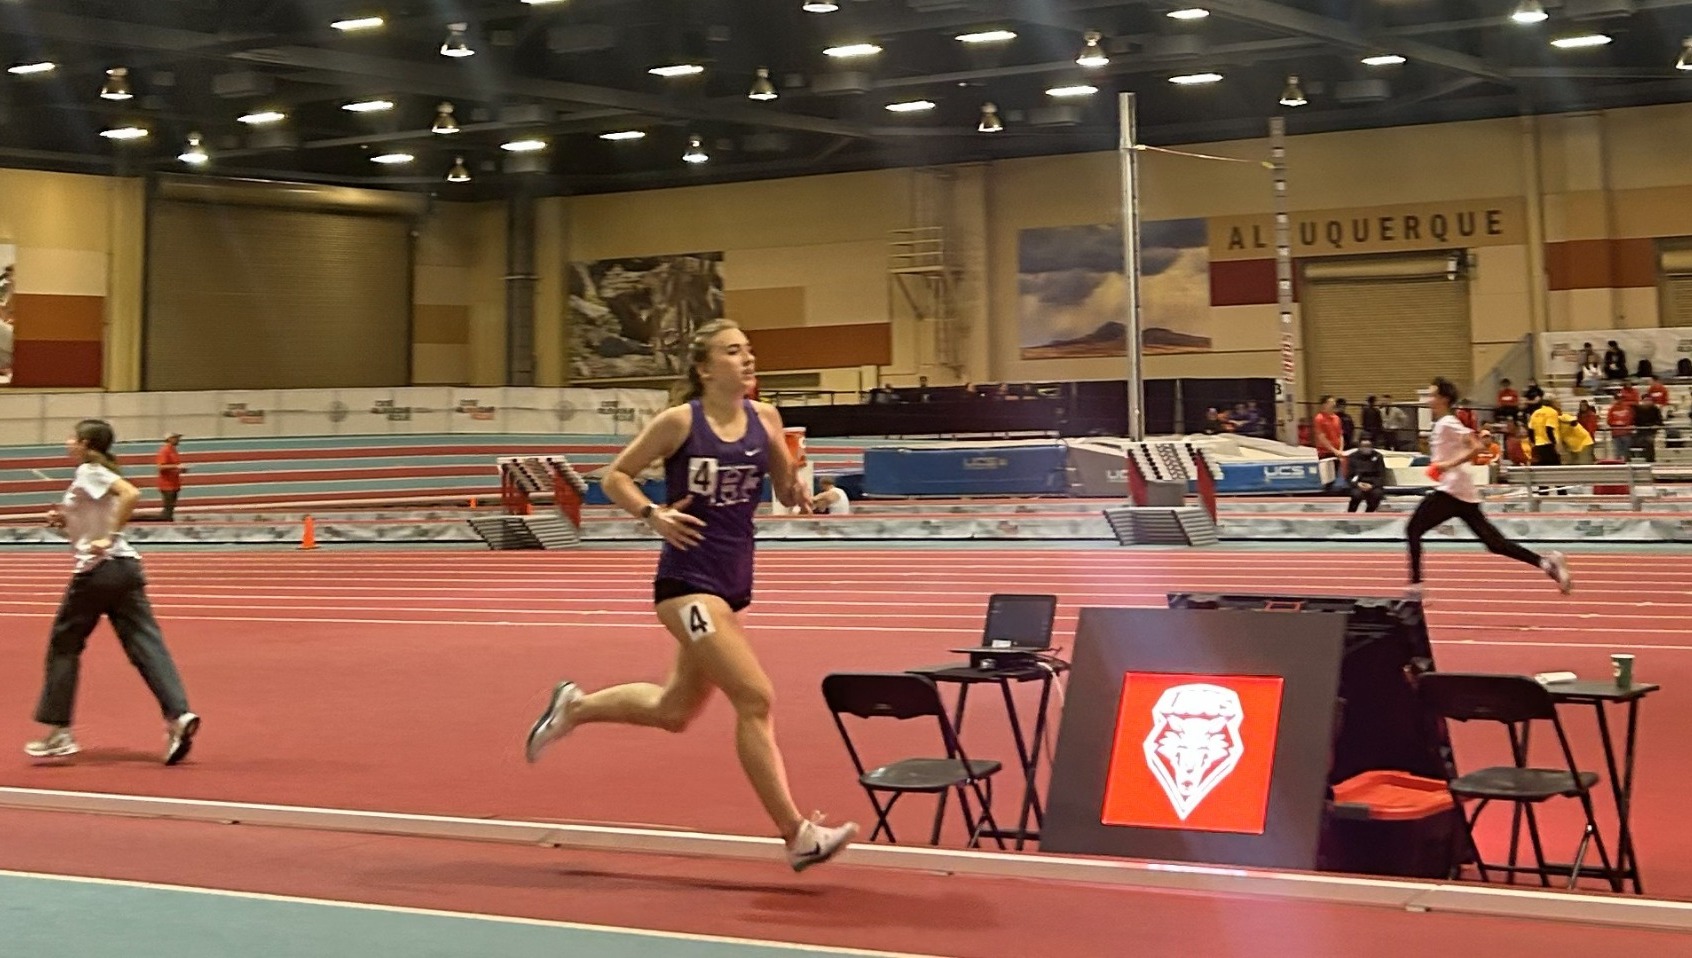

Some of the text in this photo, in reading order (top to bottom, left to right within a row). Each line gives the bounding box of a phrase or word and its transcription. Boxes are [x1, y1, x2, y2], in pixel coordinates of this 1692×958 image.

[1229, 210, 1503, 250] ALUQUERQUE
[694, 461, 710, 491] 4
[1264, 466, 1305, 476] UCS
[689, 605, 708, 632] 4
